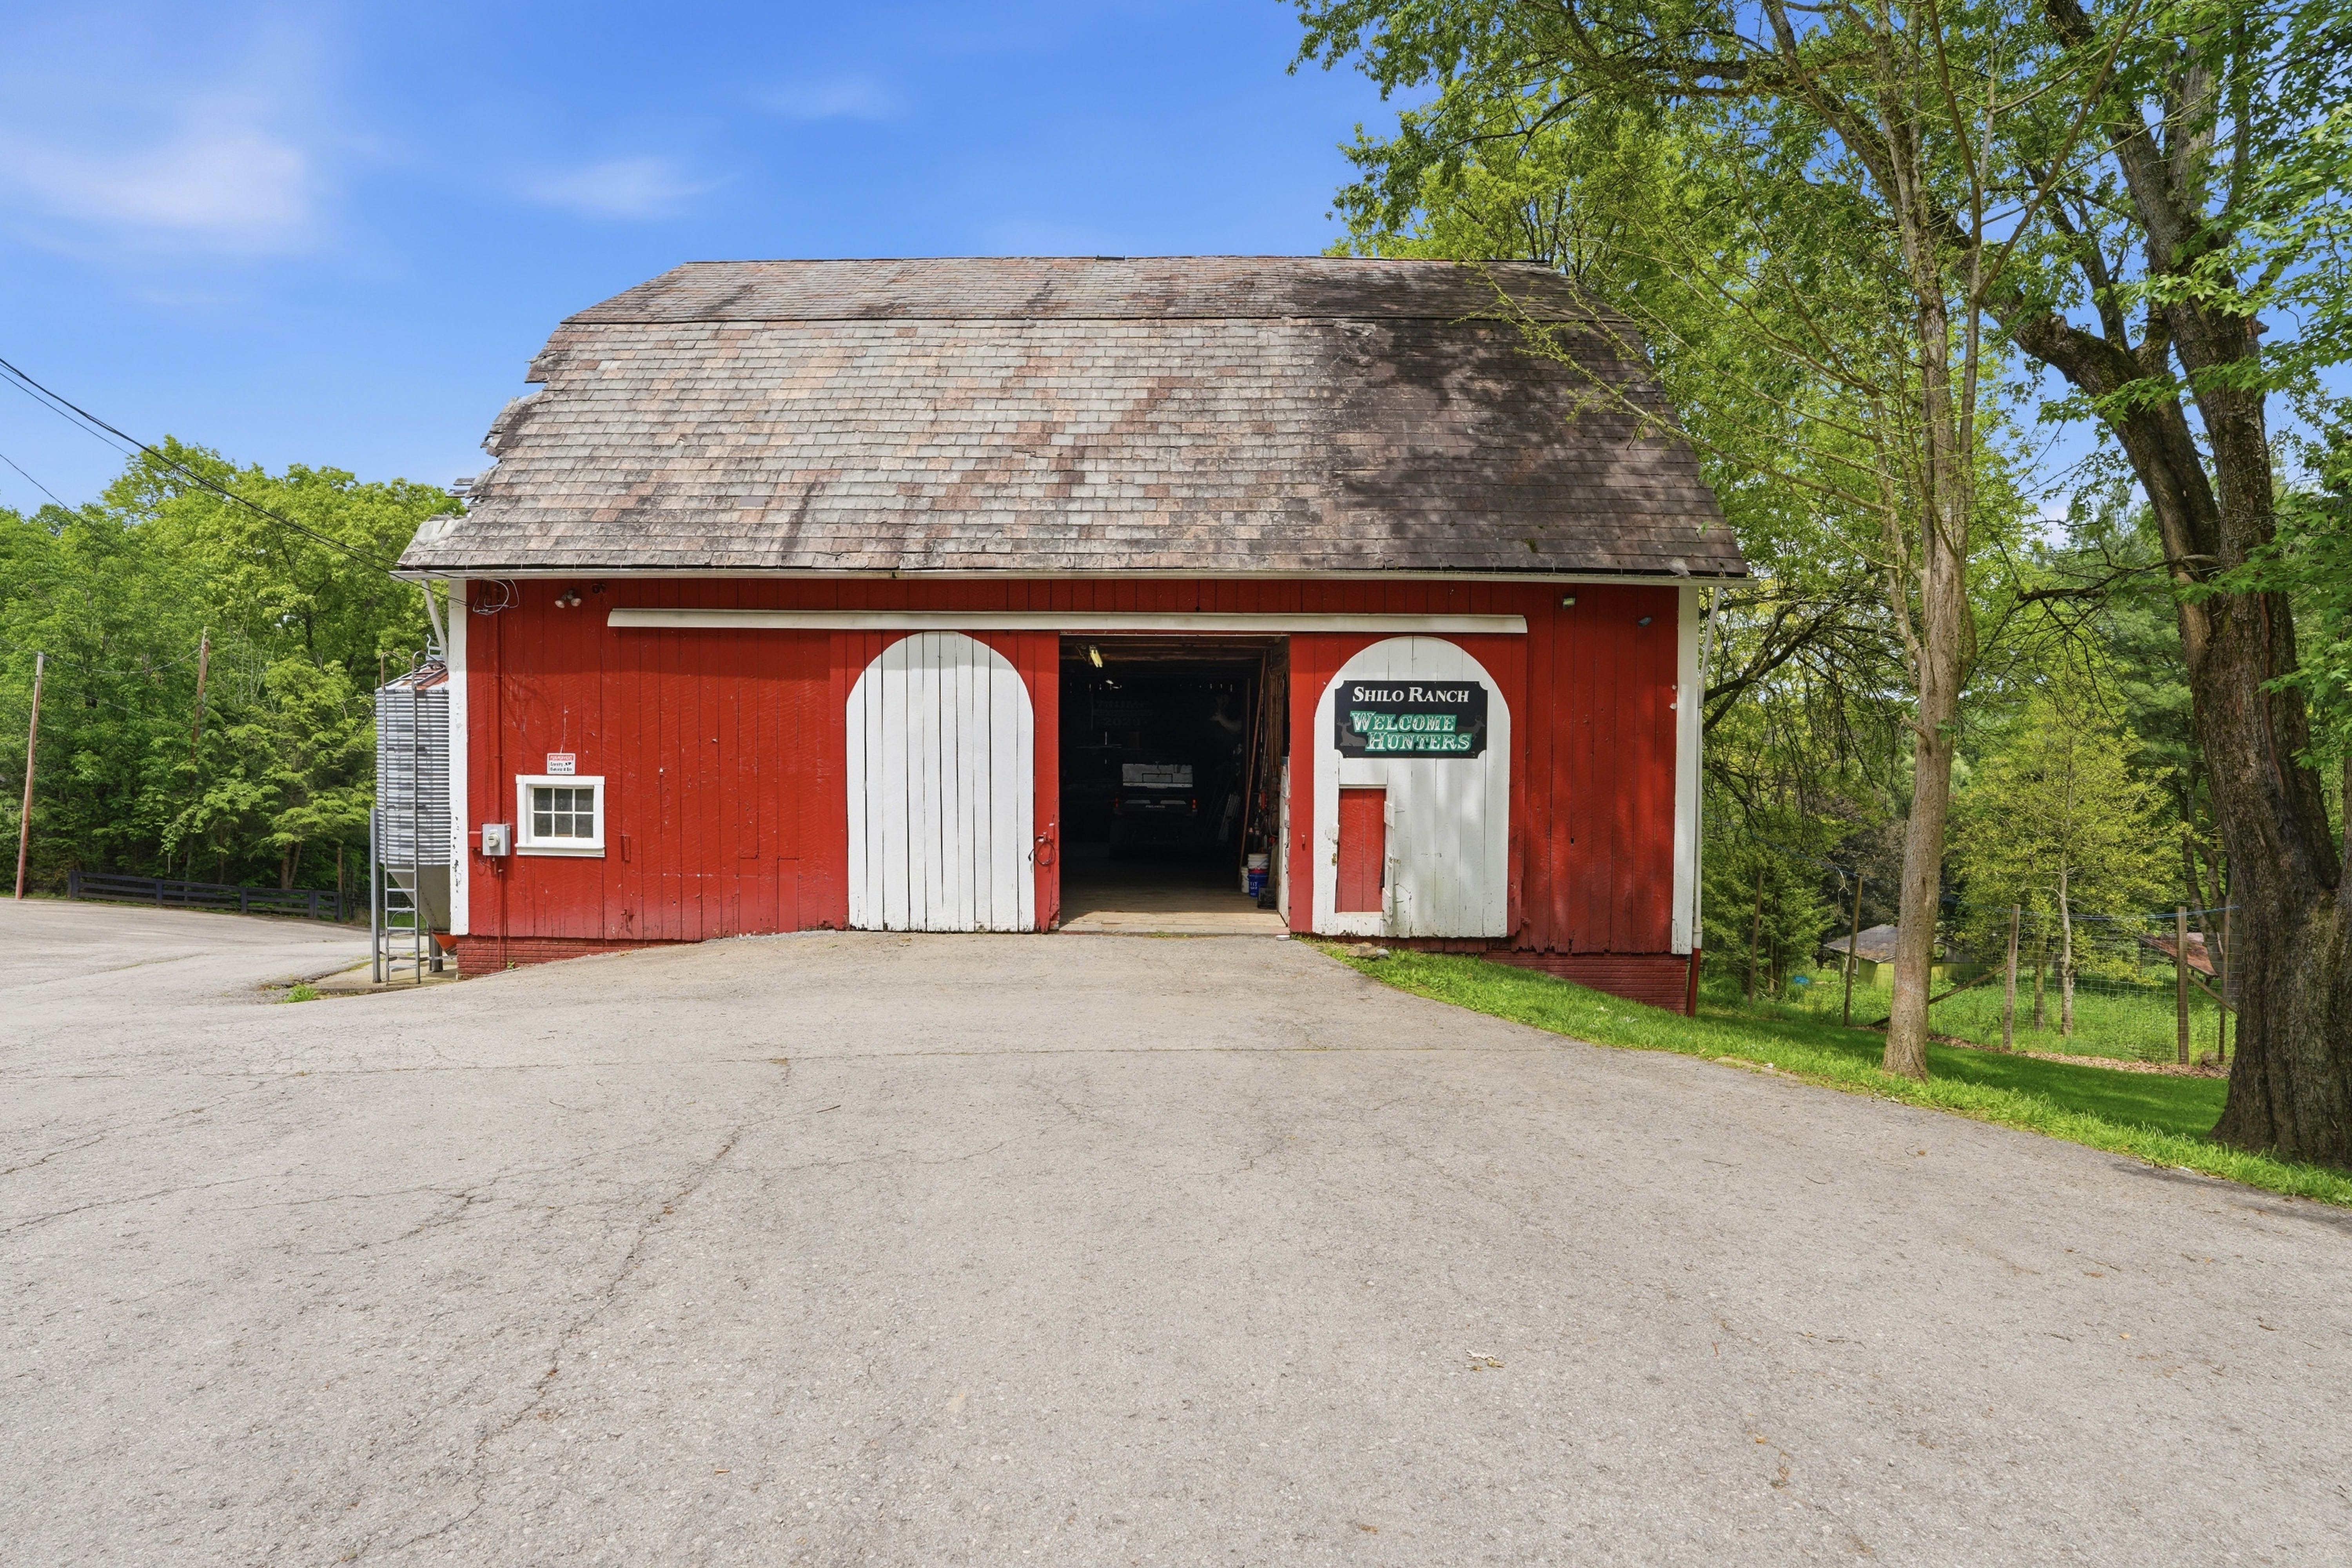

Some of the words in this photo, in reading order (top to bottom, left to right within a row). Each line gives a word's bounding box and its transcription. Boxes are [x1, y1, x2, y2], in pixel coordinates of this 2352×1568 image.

[1352, 686, 1405, 702] SHILO
[1408, 687, 1470, 703] RANCH
[1351, 711, 1456, 732] WELCOME
[1366, 732, 1472, 751] HUNTERS
